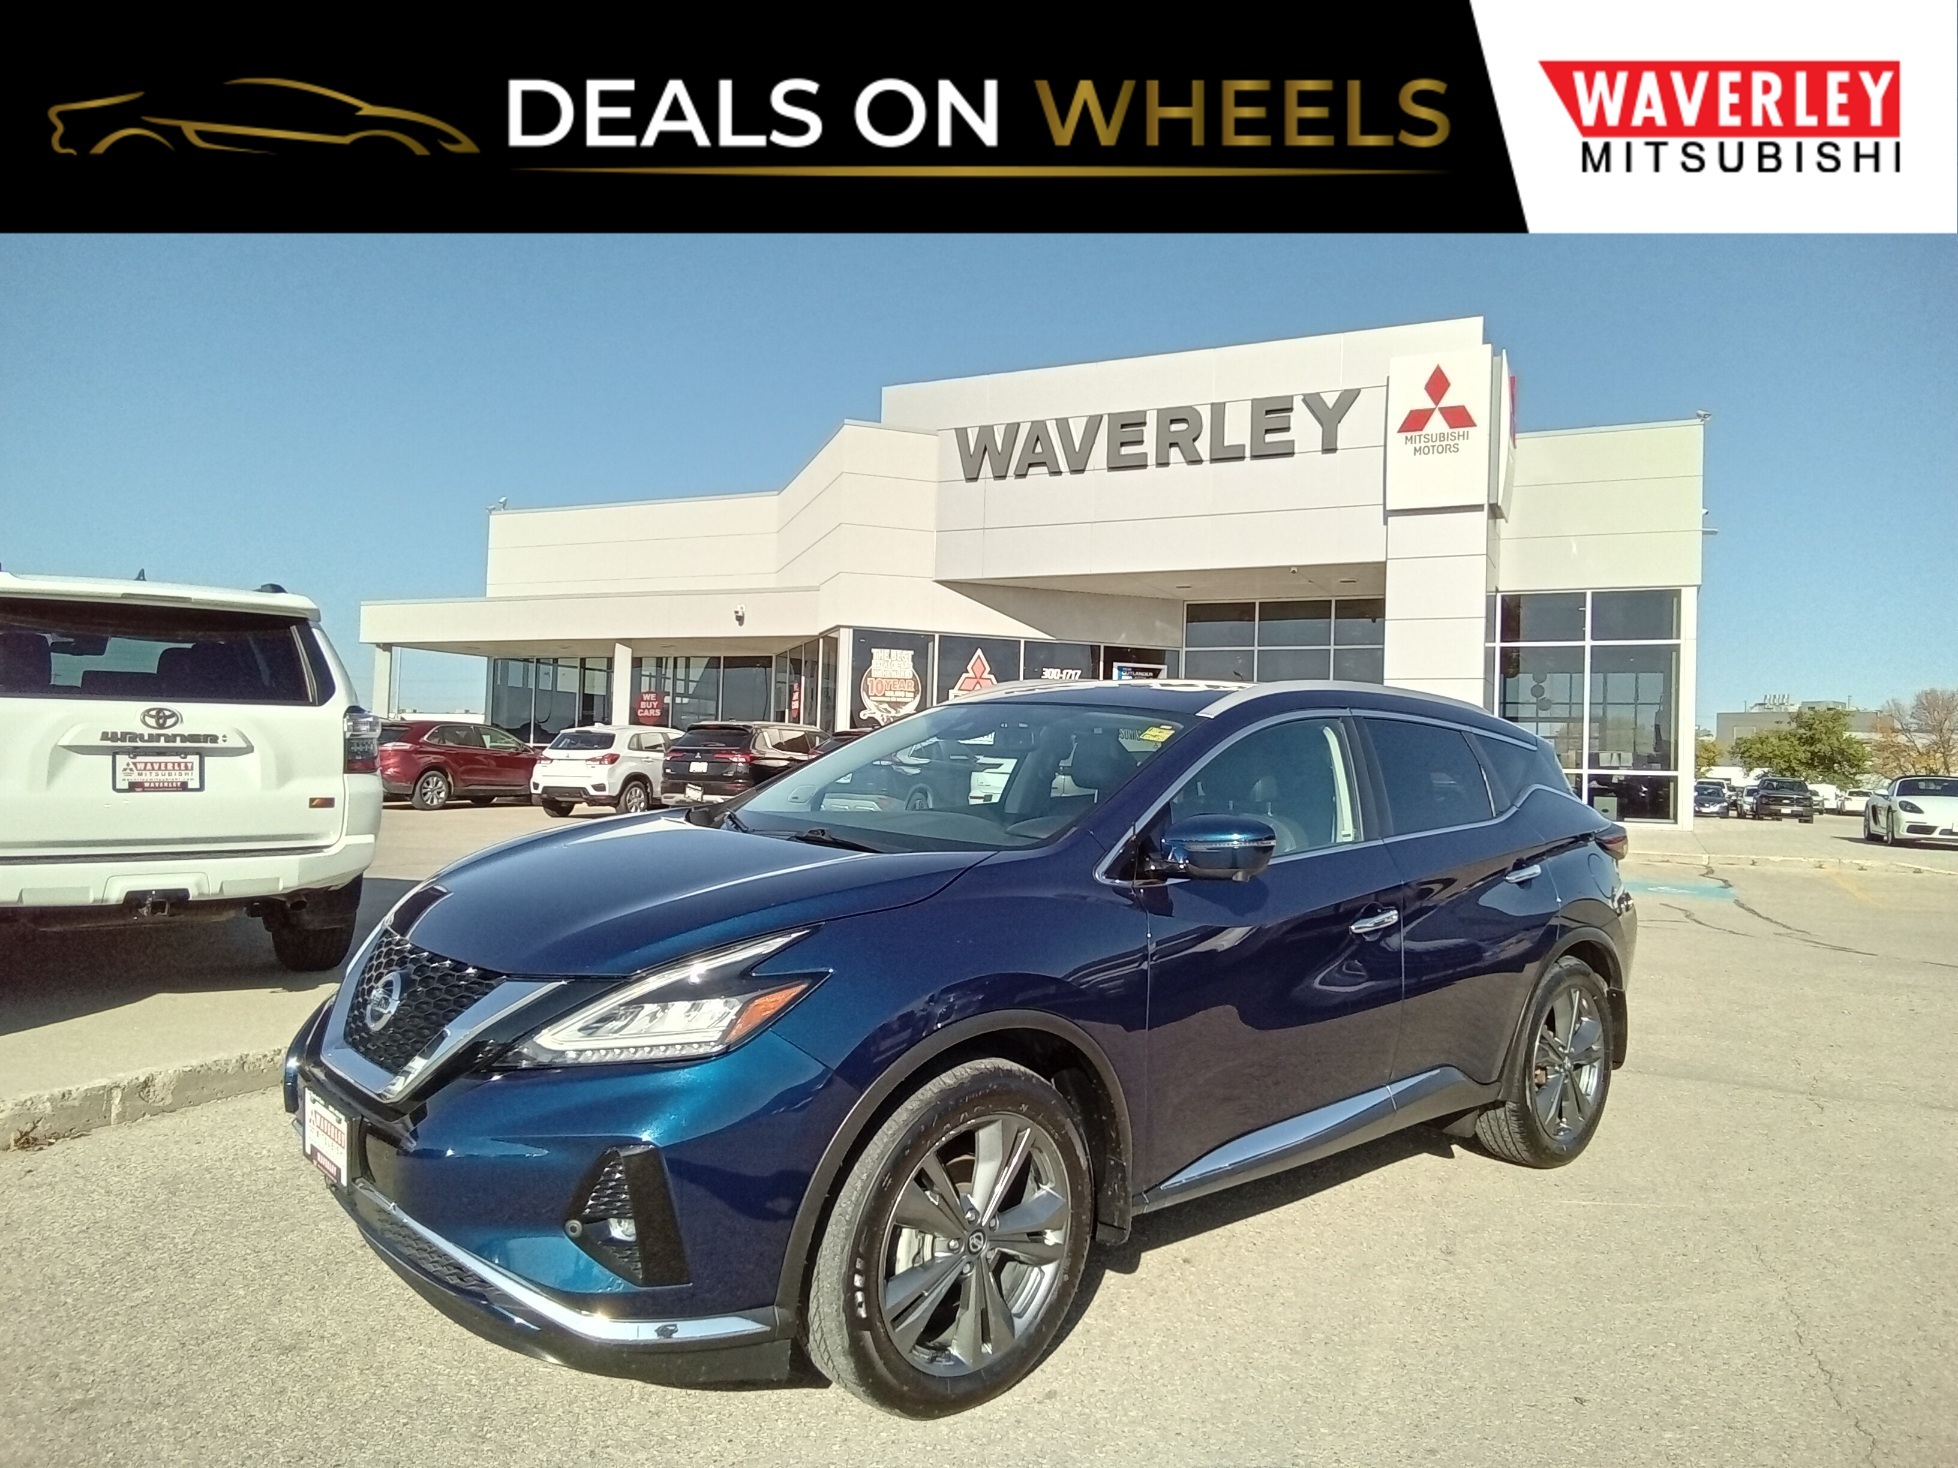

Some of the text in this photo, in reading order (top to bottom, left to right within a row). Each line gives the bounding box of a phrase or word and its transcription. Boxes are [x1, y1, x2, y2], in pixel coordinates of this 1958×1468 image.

[954, 387, 1361, 482] WAVERLEY
[1405, 431, 1469, 445] MITSUBISHI
[1414, 443, 1459, 456] MOTORS
[871, 648, 914, 662] THE BEST
[1040, 667, 1083, 680] 300-1717
[867, 677, 886, 697] 10
[885, 679, 915, 692] YEAR
[642, 693, 657, 702] WE
[640, 701, 659, 710] BUY
[637, 708, 661, 718] CARS
[136, 762, 194, 771] WAVERLEY
